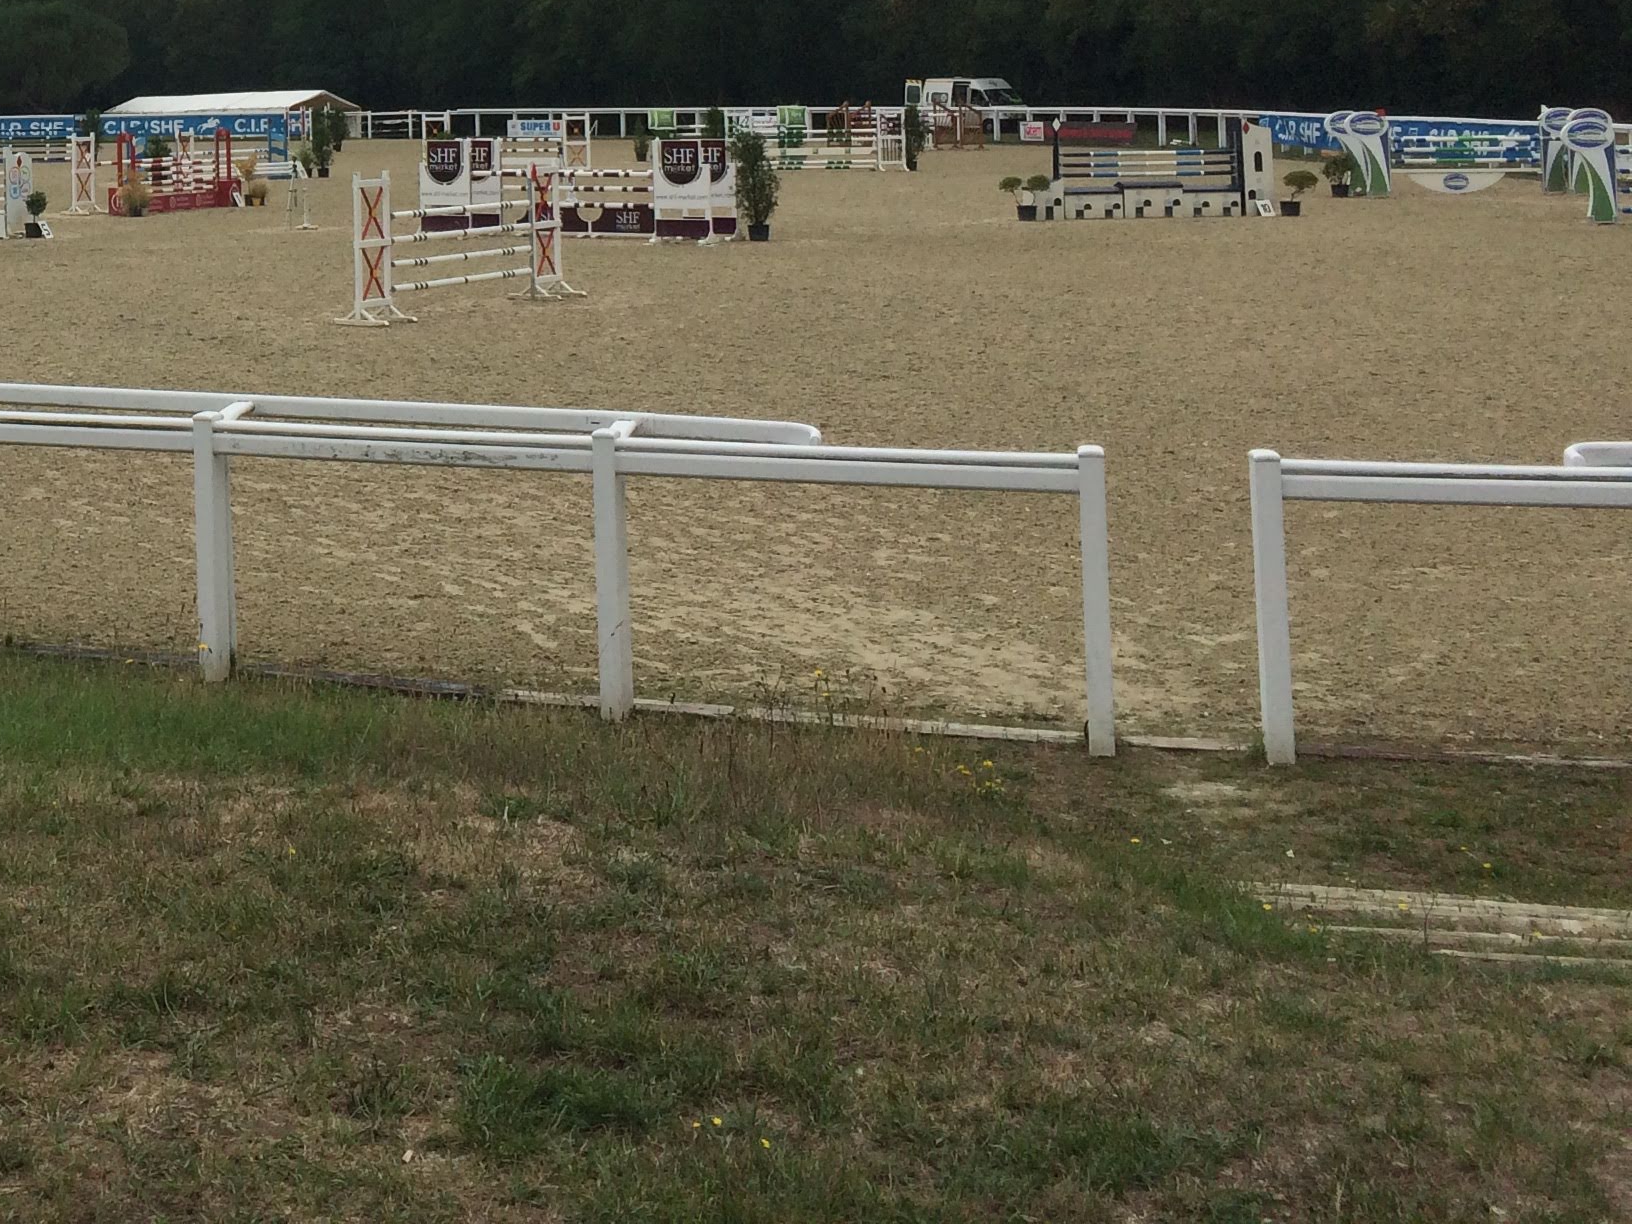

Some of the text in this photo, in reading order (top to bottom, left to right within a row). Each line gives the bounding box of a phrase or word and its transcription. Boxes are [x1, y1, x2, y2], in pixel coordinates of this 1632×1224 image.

[150, 119, 185, 134] SHF
[520, 121, 561, 132] SUPER U
[1299, 120, 1321, 145] SHF
[429, 147, 458, 163] SHF
[470, 147, 489, 162] HF
[663, 148, 696, 165] SHF
[700, 147, 723, 163] HF
[664, 164, 696, 173] market
[615, 211, 641, 224] SHF
